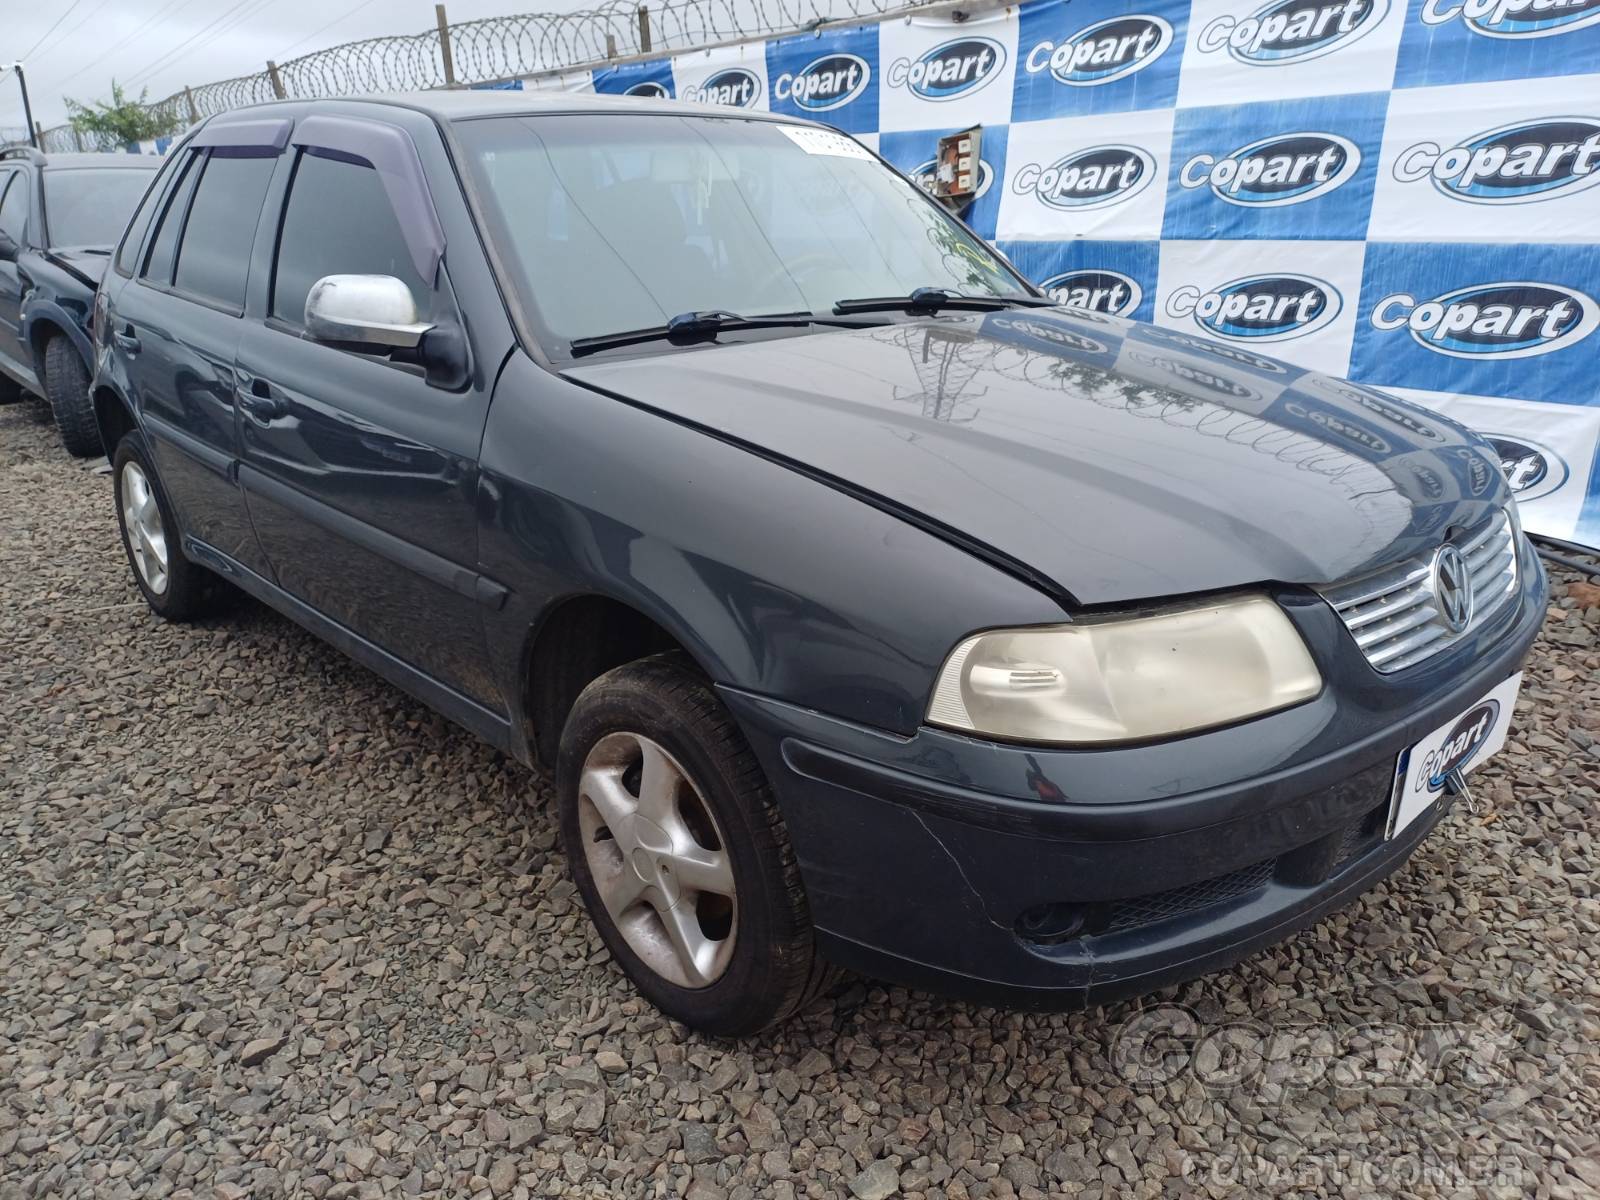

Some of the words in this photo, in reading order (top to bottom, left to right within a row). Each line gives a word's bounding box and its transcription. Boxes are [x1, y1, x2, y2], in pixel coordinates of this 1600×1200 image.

[1026, 23, 1157, 76] Copart
[1197, 0, 1364, 54] Copart
[775, 62, 859, 101] Copart
[888, 45, 991, 89] Copart
[1012, 148, 1138, 197] Copart
[1179, 144, 1345, 193] Copart
[1393, 132, 1600, 188] Copart
[1038, 281, 1126, 314] part
[1166, 284, 1321, 327] Copart
[1370, 286, 1573, 341] Copart
[1415, 711, 1488, 793] Copart
